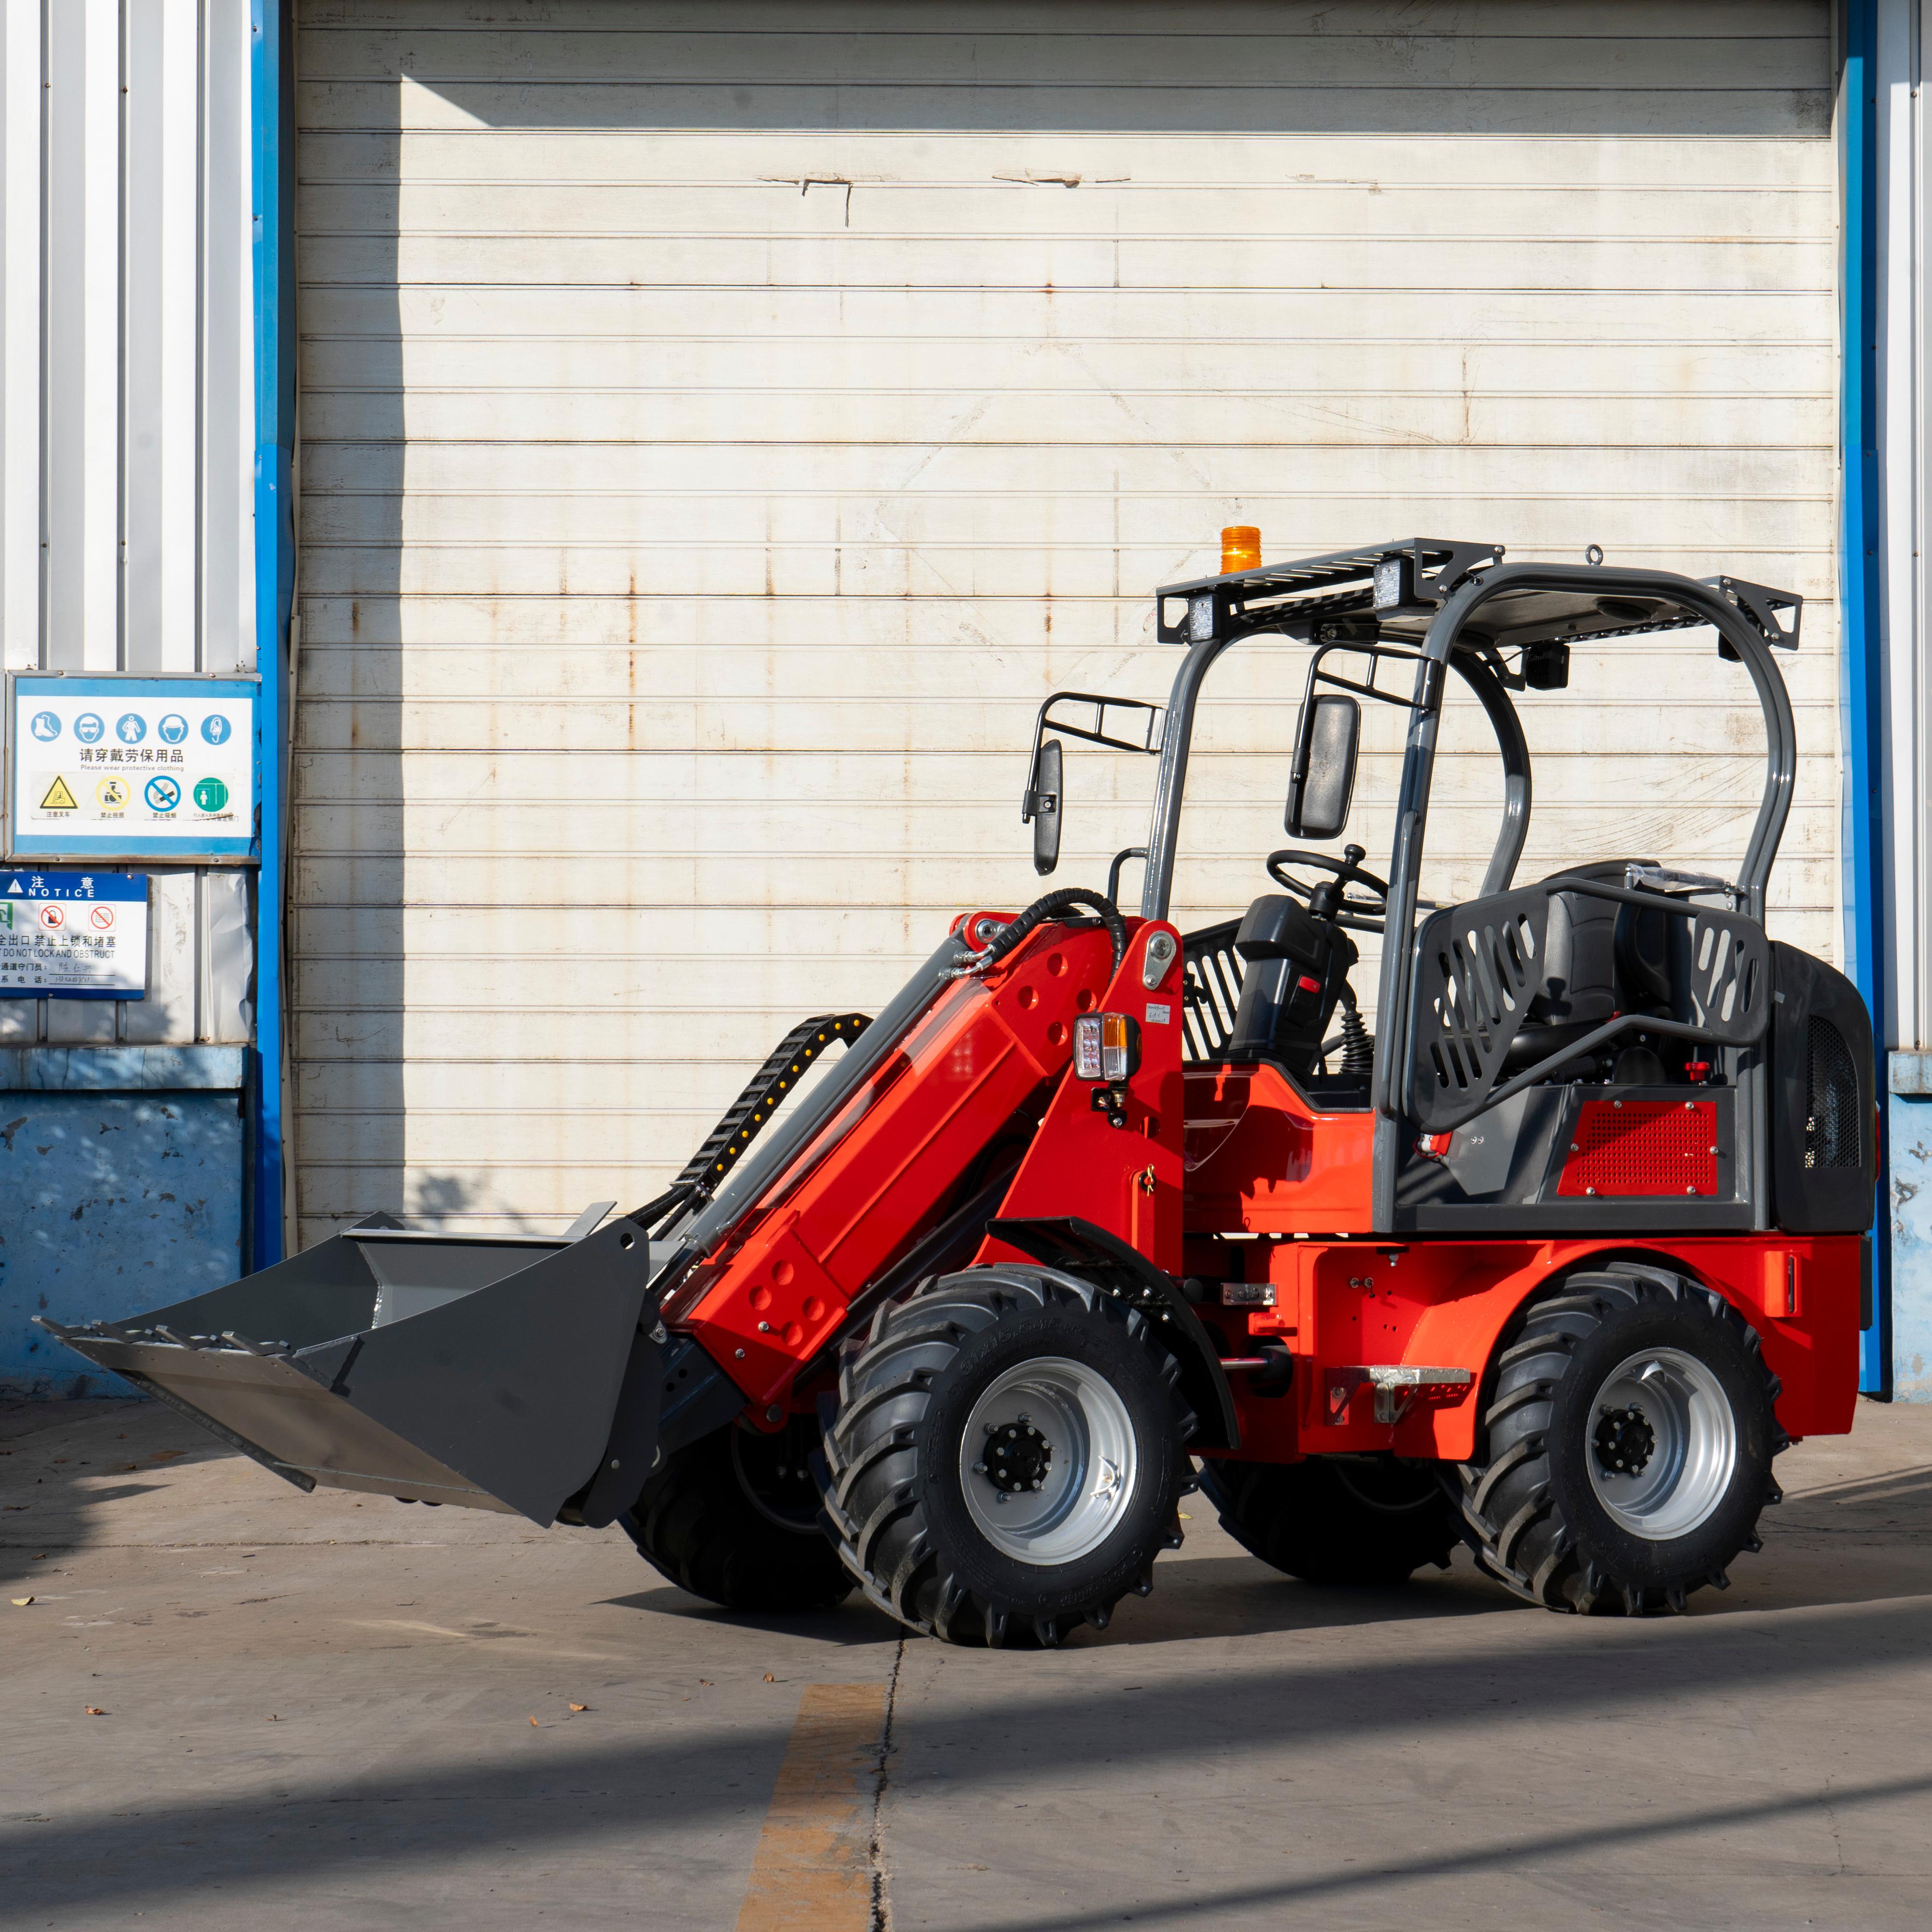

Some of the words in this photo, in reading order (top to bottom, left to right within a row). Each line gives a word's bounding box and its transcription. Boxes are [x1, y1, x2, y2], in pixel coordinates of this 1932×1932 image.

[80, 749, 184, 762] 请穿戴劳保用品
[28, 888, 94, 897] NOTICE
[35, 935, 116, 948] 禁止上锁和堵塞
[4, 949, 14, 957] DO
[16, 949, 32, 957] NOT
[34, 949, 55, 957] LOCK
[56, 950, 71, 958] AND
[73, 950, 115, 958] OBSTRUCT
[0, 963, 47, 971] 通道守门员：
